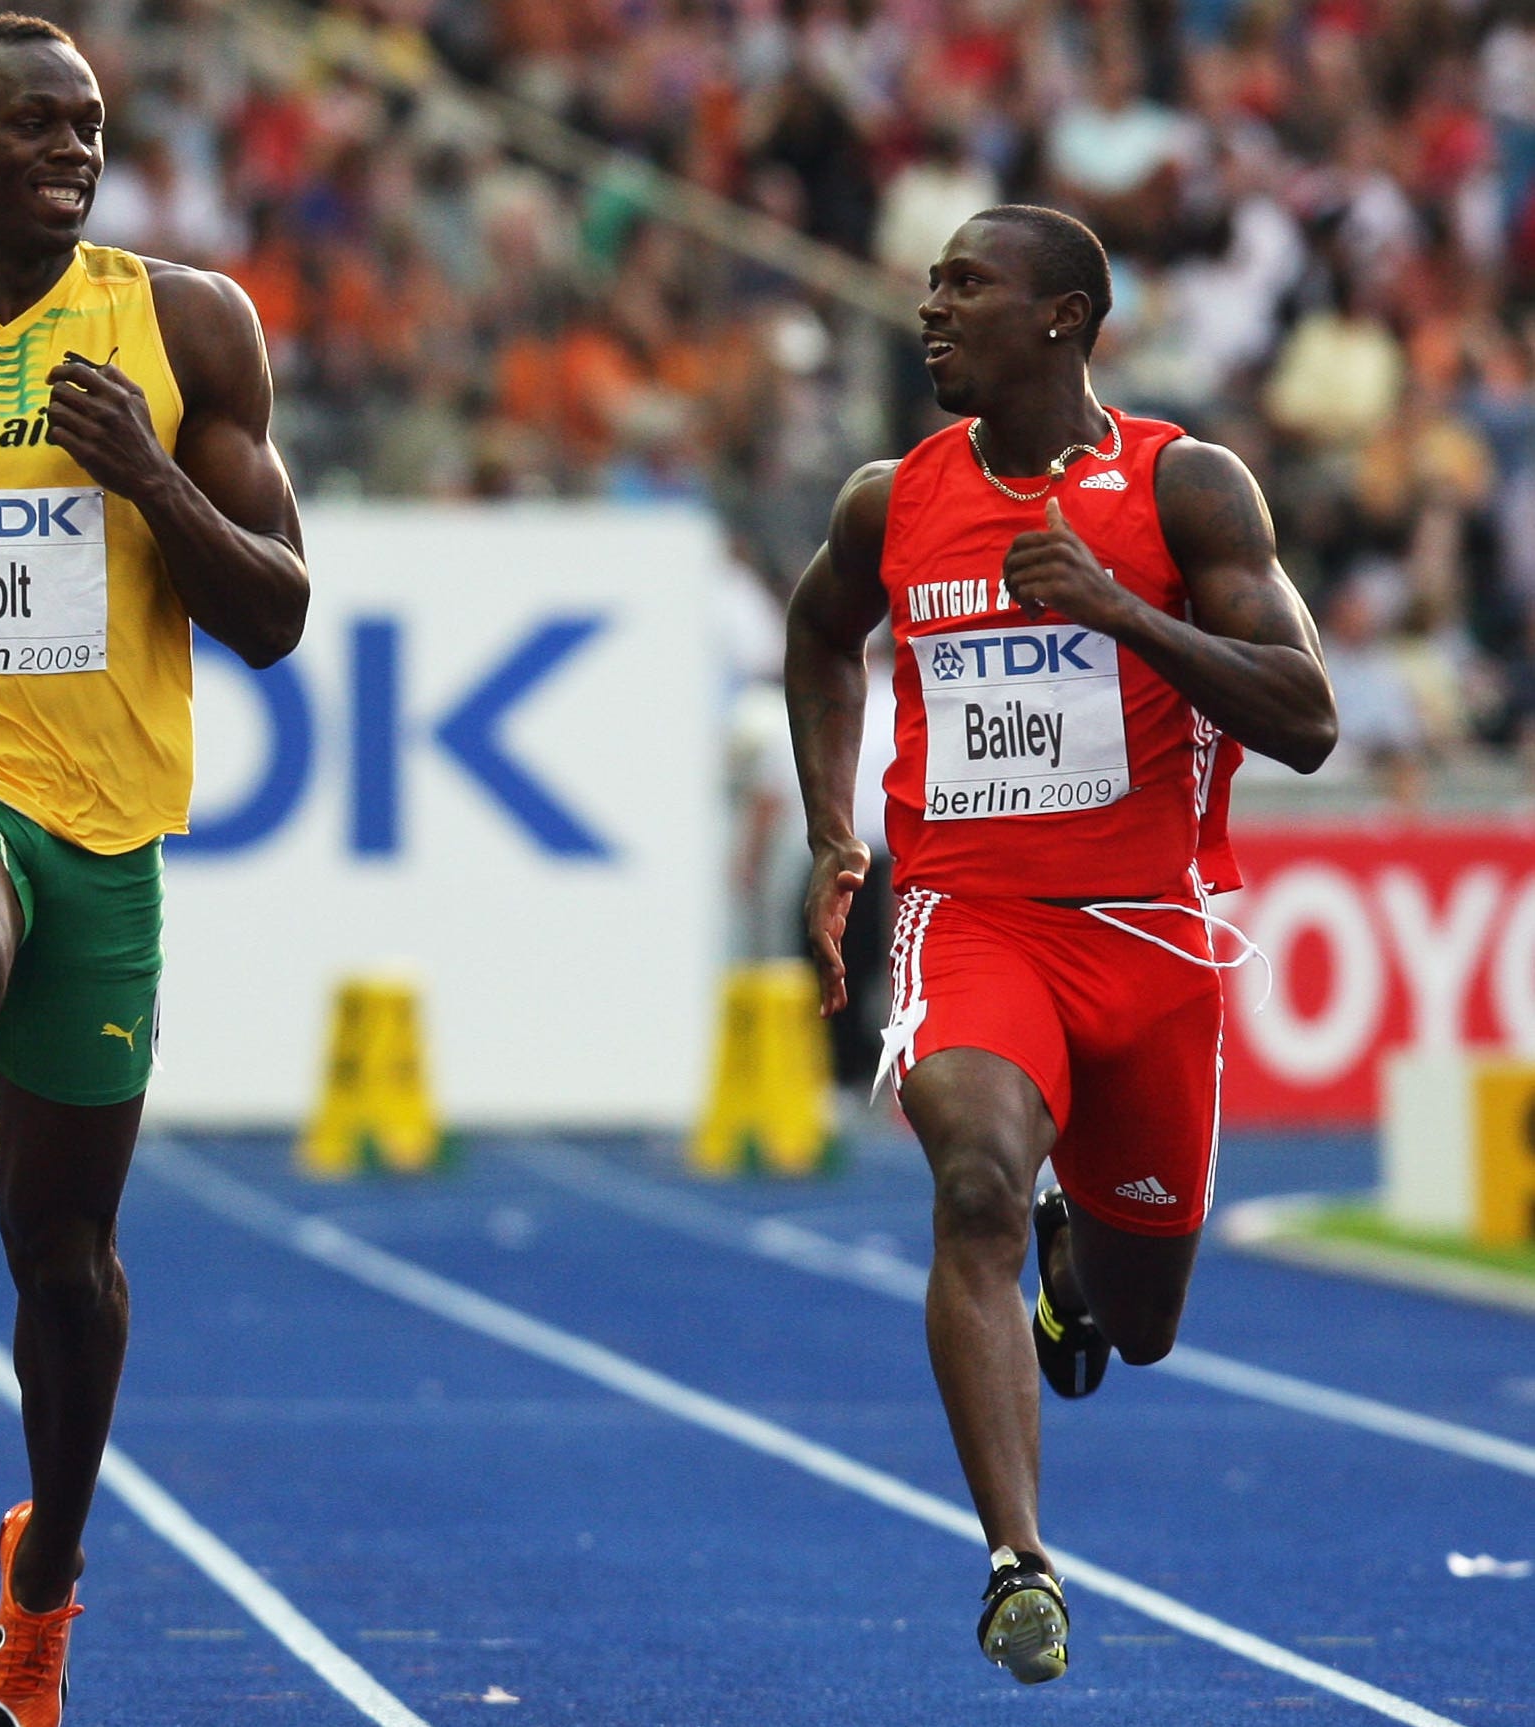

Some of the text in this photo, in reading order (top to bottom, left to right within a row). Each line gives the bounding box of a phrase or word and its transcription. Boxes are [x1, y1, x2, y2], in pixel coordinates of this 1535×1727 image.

[1079, 479, 1129, 491] adida
[907, 578, 988, 623] ANTIGUA
[996, 578, 1010, 611] &
[18, 644, 90, 670] 2009
[960, 631, 1094, 678] TDK
[965, 700, 1063, 768] Bailey
[931, 778, 1112, 815] berlin 2009
[1115, 1186, 1178, 1205] adidas
